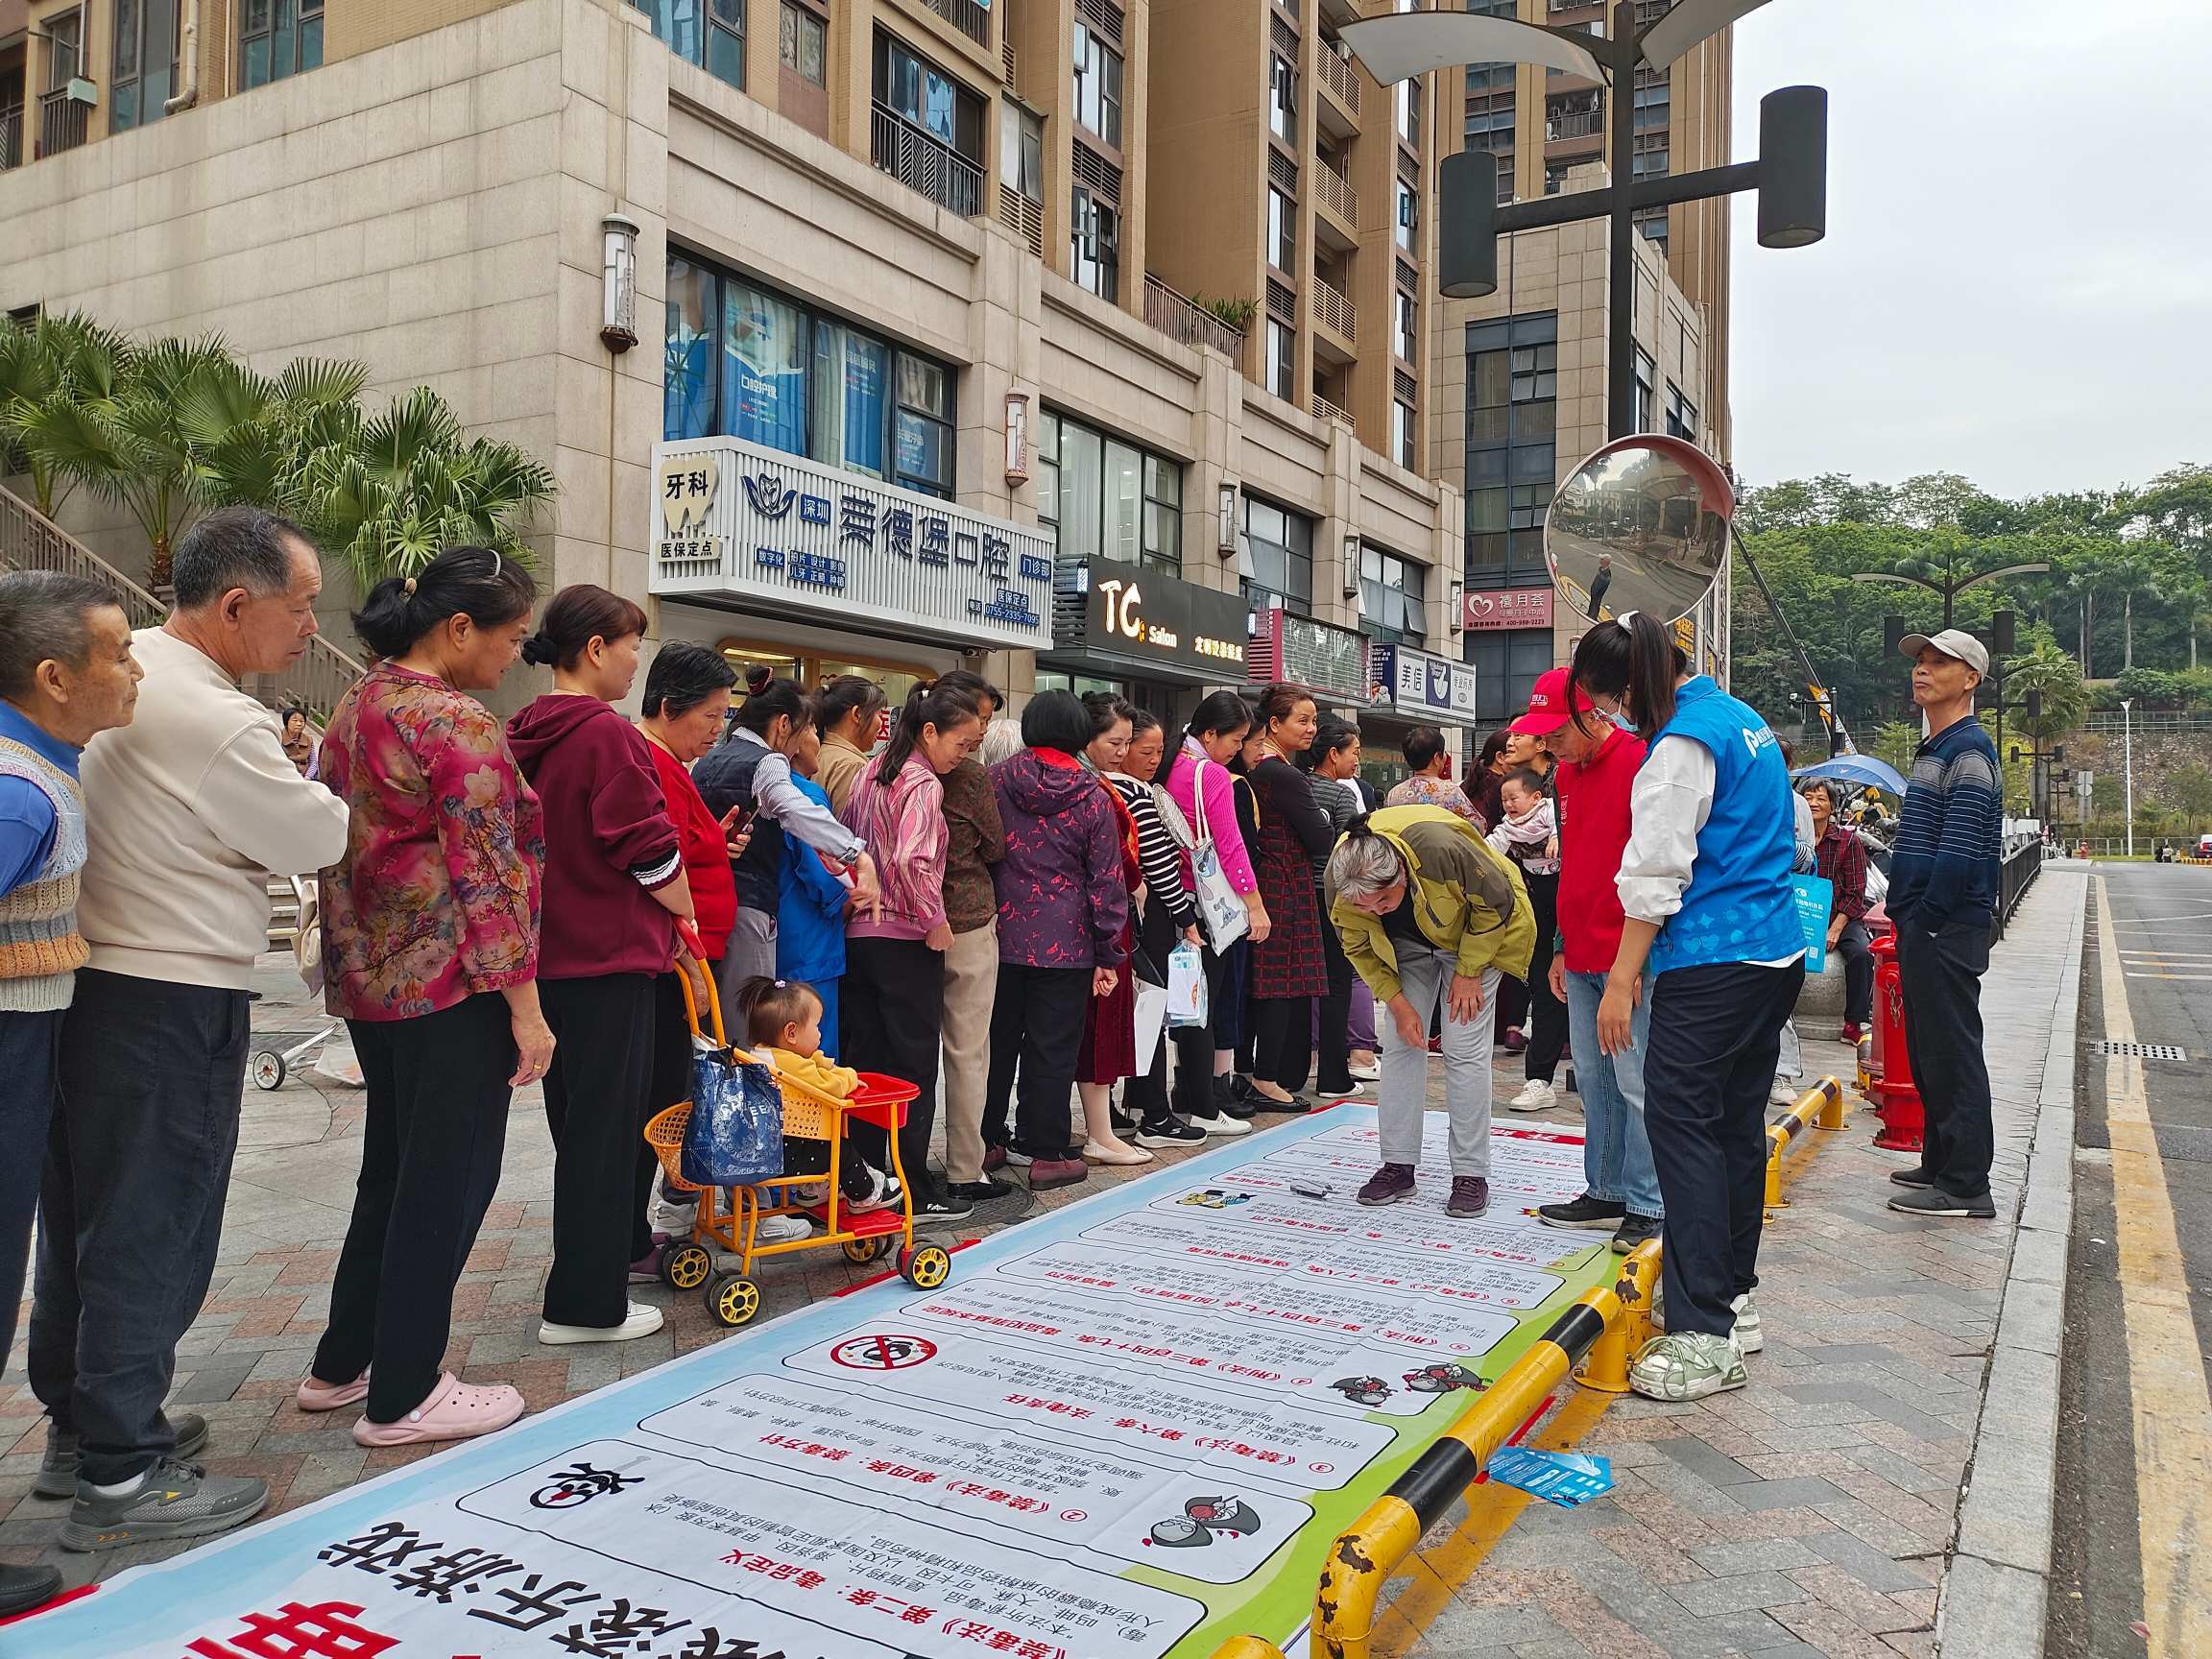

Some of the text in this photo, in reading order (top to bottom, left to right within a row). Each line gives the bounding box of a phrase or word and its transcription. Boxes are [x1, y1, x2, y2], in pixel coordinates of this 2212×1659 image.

[664, 469, 709, 499] 牙科
[661, 539, 714, 558] 医保定点
[803, 496, 830, 521] 深圳
[1022, 556, 1051, 579] 门诊部
[998, 589, 1028, 608] 医保定点
[1401, 662, 1423, 692] 美信
